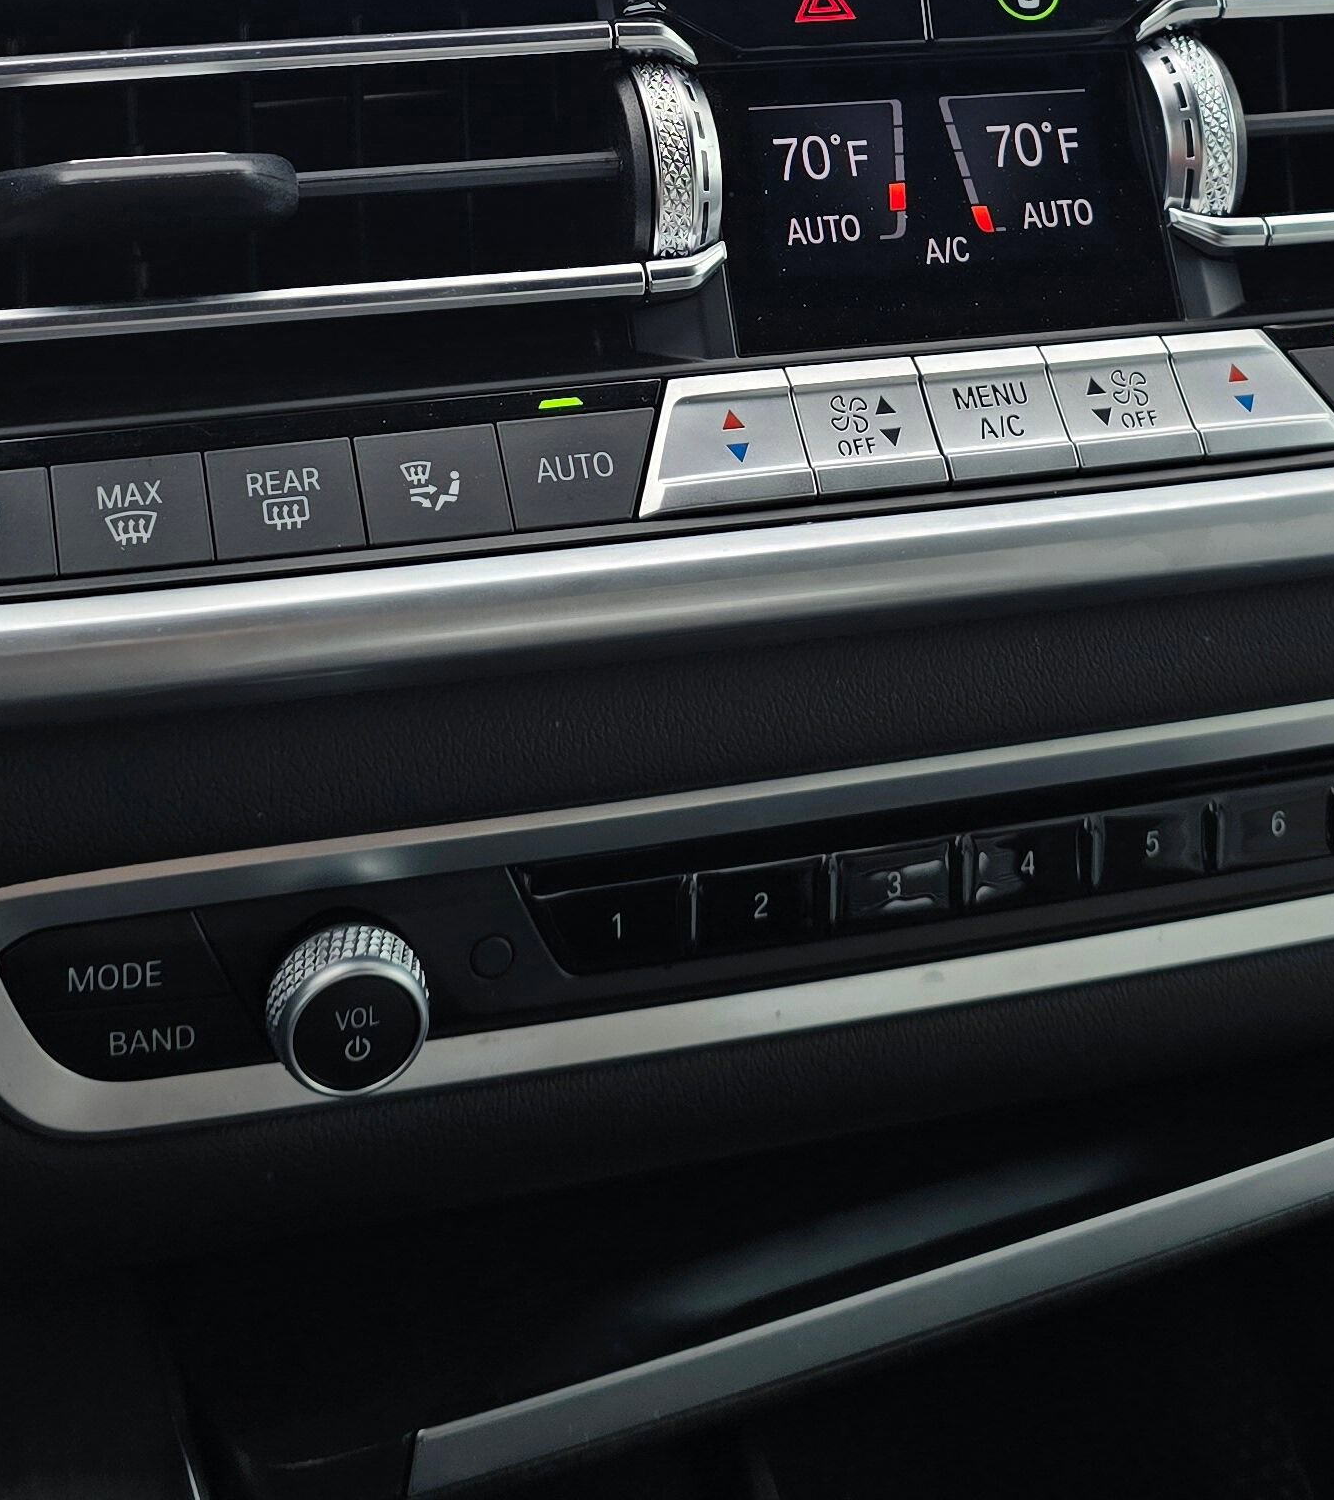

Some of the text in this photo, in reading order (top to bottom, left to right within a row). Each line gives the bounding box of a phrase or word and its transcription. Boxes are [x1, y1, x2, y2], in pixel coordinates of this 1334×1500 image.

[772, 132, 869, 182] 70°F
[985, 121, 1080, 169] 70°F
[1022, 198, 1094, 231] AUTO
[786, 214, 861, 247] AUTO
[925, 236, 970, 265] A/C
[952, 381, 1028, 411] MENU
[979, 413, 1025, 440] A/C
[1121, 409, 1158, 429] OFF
[836, 436, 876, 457] OFF
[535, 450, 615, 484] AUTO
[95, 479, 163, 511] MAX
[245, 466, 321, 498] REAR
[1270, 810, 1287, 837] 6
[1145, 830, 1160, 858] 5
[1019, 849, 1036, 877] 4
[886, 871, 903, 899] 3
[753, 892, 769, 920] 2
[610, 912, 623, 940] 1
[67, 959, 163, 993] MODE
[334, 1006, 381, 1032] VOL
[108, 1024, 197, 1057] BAND
